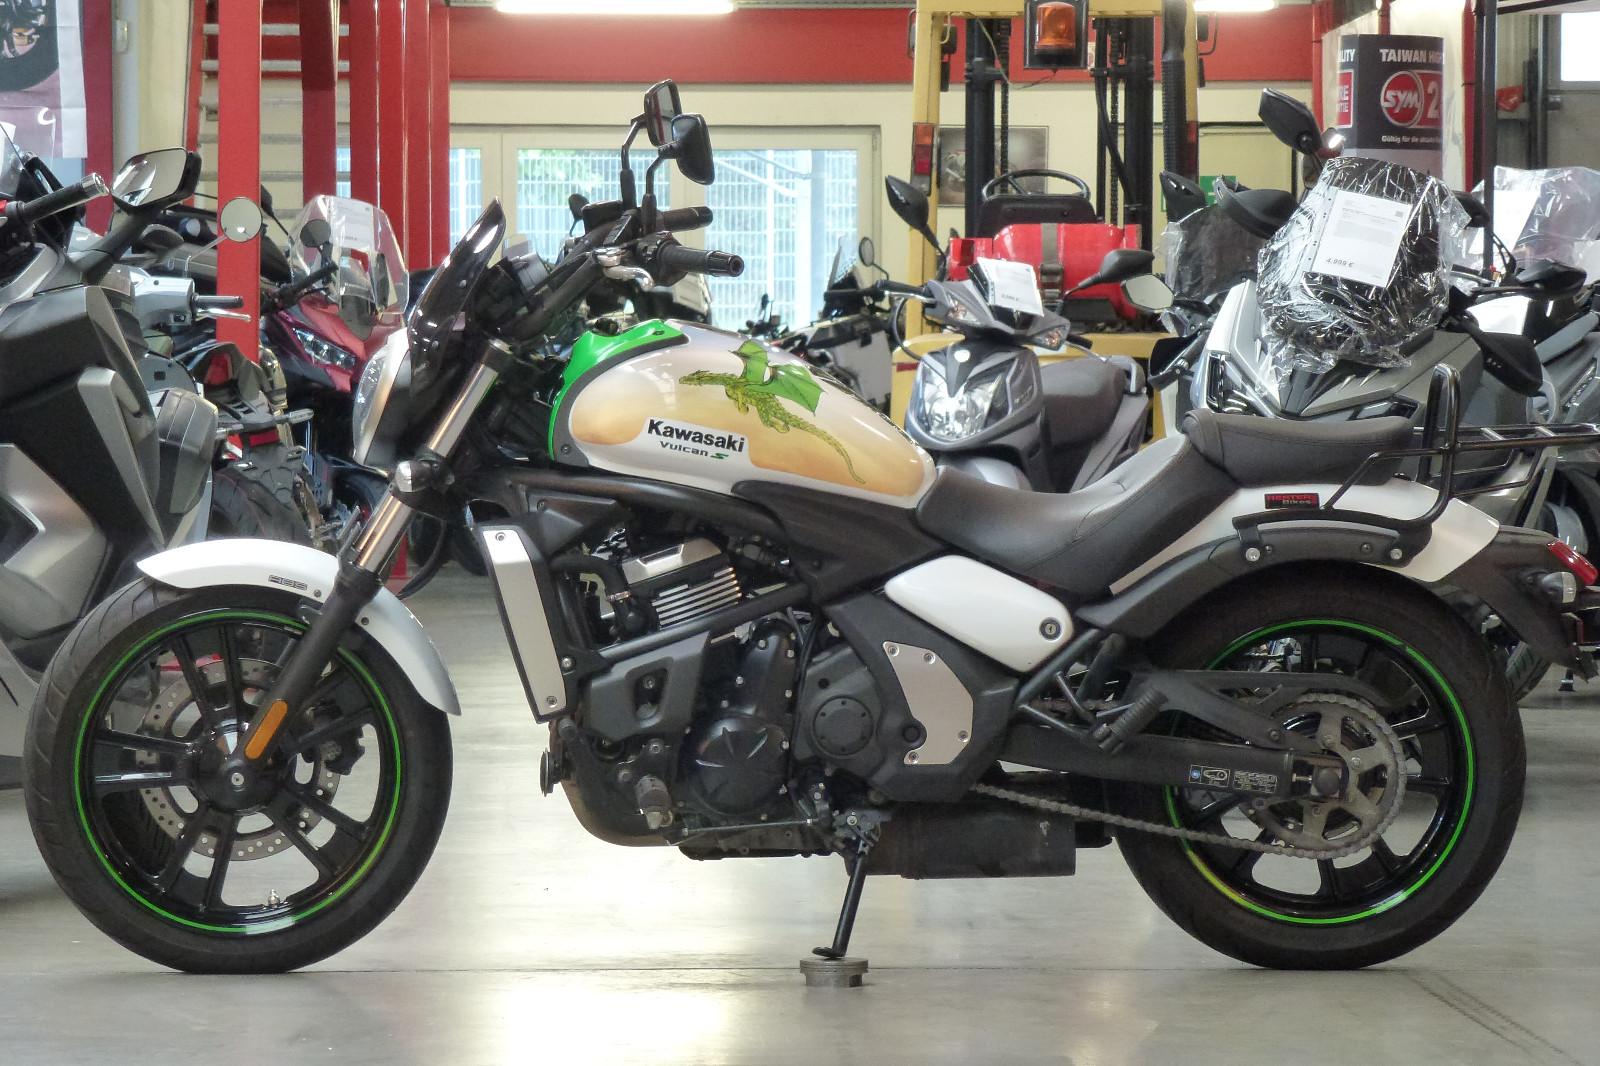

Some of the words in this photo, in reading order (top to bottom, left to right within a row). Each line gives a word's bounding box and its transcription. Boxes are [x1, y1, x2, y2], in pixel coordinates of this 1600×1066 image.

[1379, 49, 1427, 63] TAIWAN
[1381, 89, 1420, 114] SYM
[1426, 80, 1442, 119] 2
[648, 419, 745, 452] Kawasaki
[268, 575, 308, 590] ABS
